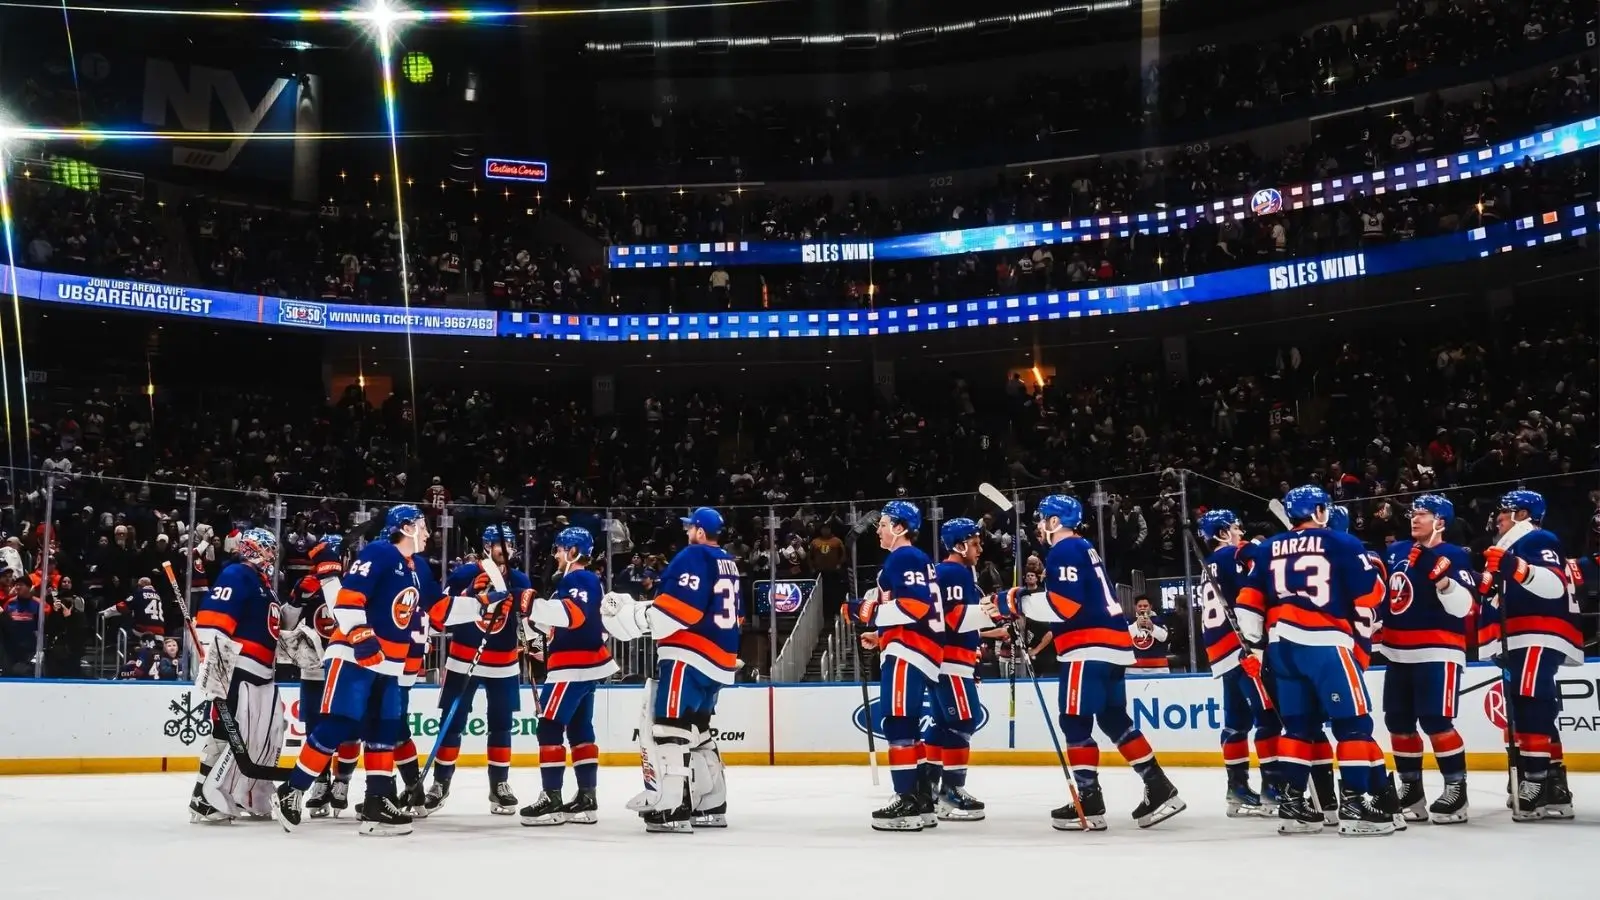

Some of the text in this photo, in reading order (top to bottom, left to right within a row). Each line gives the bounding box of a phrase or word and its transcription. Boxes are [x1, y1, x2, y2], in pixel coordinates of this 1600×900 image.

[929, 176, 953, 188] 202
[802, 243, 874, 263] ISLES WIN!
[1268, 254, 1364, 290] ISLES WIN!
[88, 278, 186, 296] JOIN UBS ARENA WIFI:
[58, 283, 213, 314] UBSARENAGUEST
[329, 311, 381, 324] WINNING
[383, 314, 423, 325] TICKET:
[1271, 536, 1325, 557] BARZAL
[349, 560, 372, 577] 64
[1058, 566, 1078, 582] 16
[678, 572, 700, 590] 33
[903, 570, 926, 586] 32
[1269, 554, 1331, 607] 13
[210, 586, 233, 601] 30
[946, 586, 964, 601] 10
